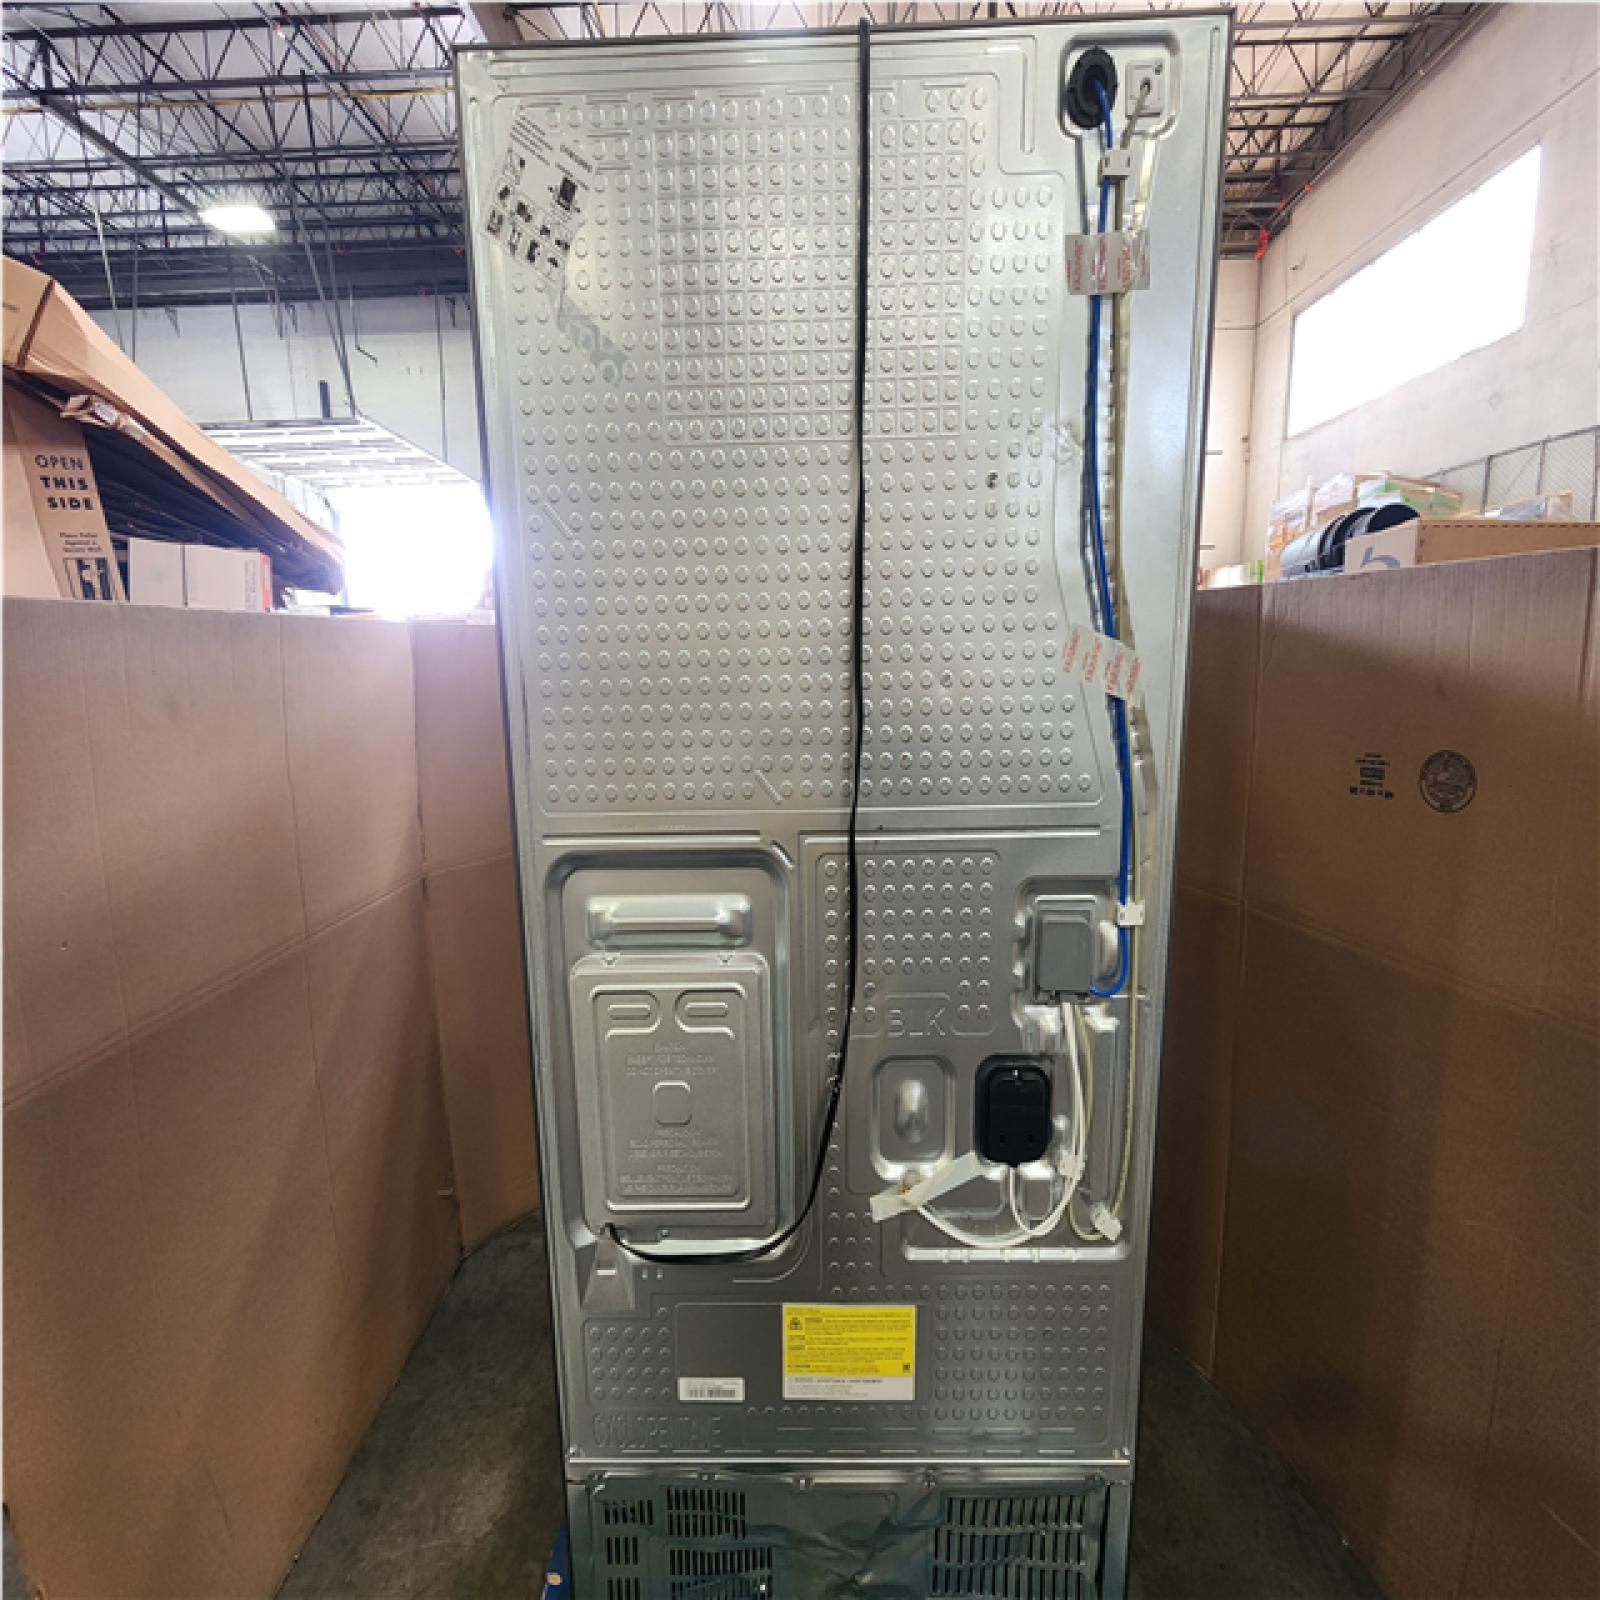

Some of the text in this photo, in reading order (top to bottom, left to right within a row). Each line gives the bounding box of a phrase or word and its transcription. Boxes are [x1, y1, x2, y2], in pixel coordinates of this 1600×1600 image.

[34, 454, 84, 470] OPEN
[40, 475, 88, 490] THIS
[47, 496, 93, 510] SIDE
[888, 1007, 947, 1037] BLK
